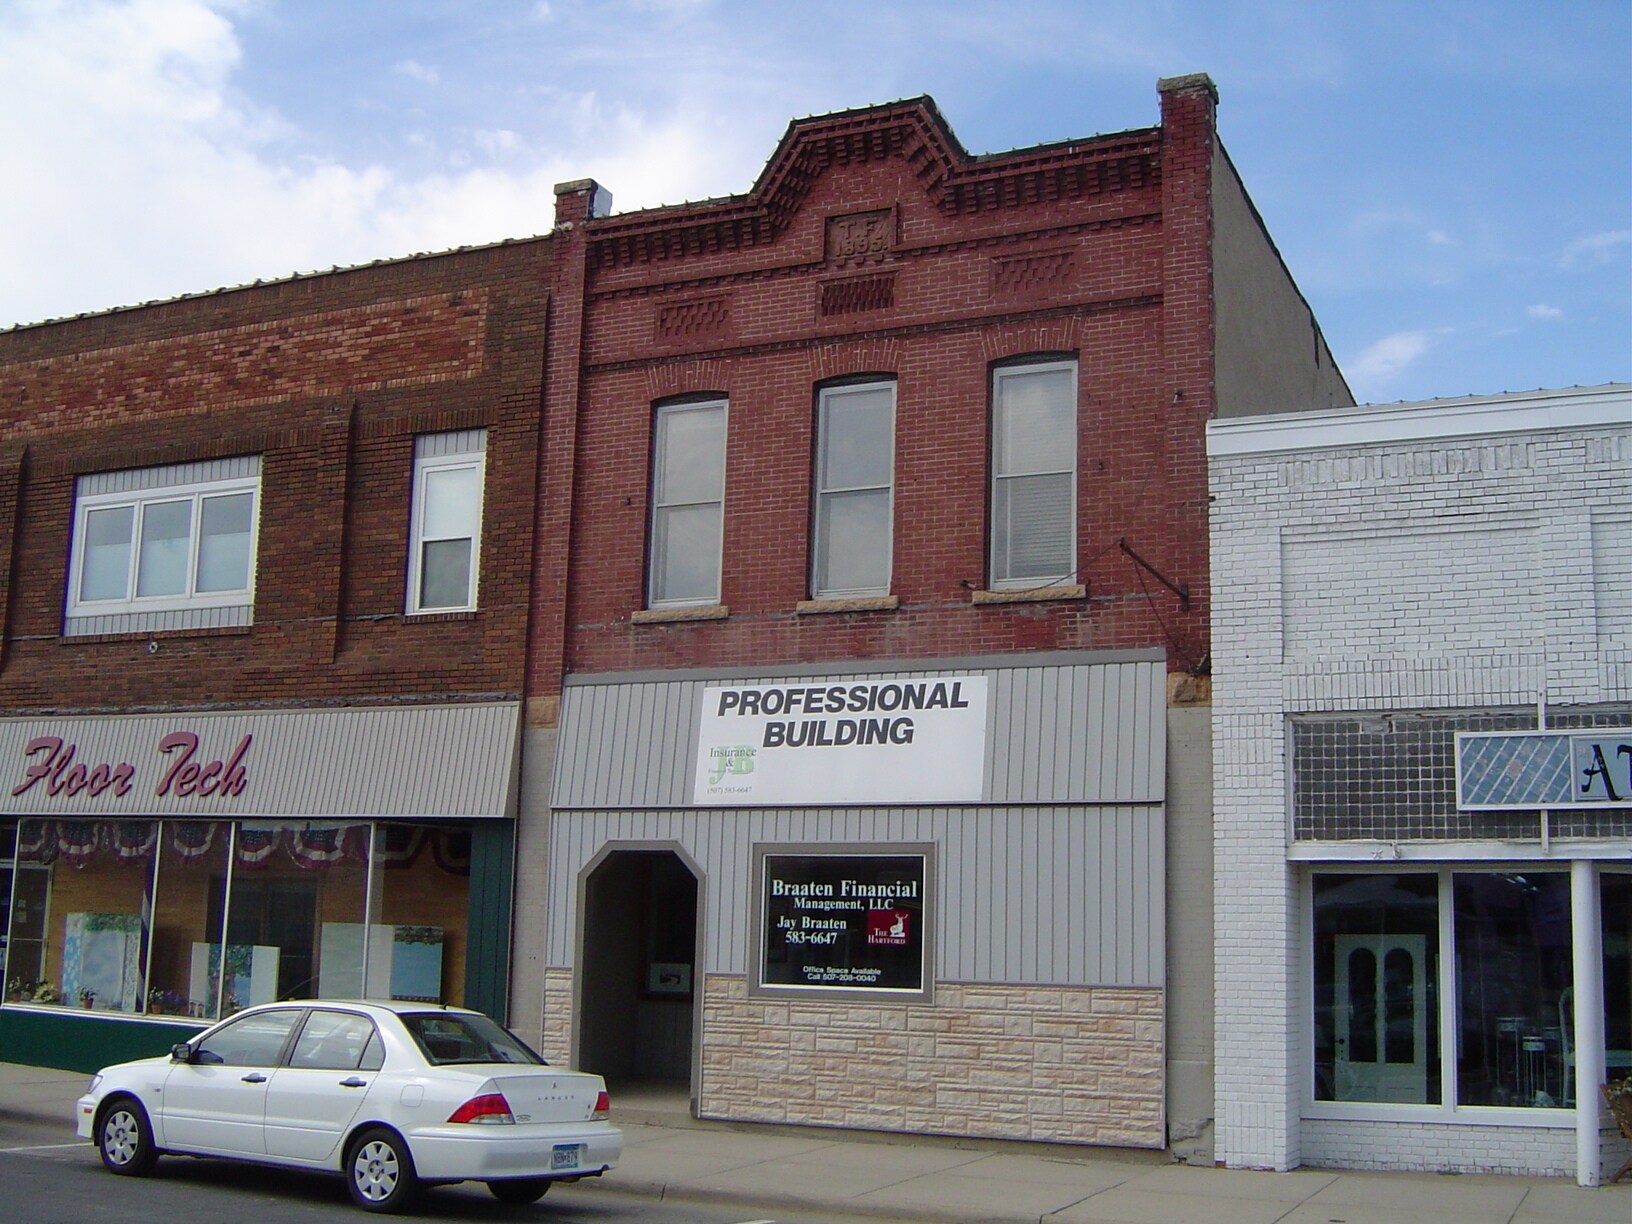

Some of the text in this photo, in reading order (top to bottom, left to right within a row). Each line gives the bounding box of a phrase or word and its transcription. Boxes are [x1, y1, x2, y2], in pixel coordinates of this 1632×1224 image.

[717, 681, 969, 717] PROFESSIONAL
[762, 717, 914, 748] BUILDING
[710, 747, 757, 758] Insurance
[12, 731, 252, 797] Floor Tech
[772, 879, 918, 898] Braaten Financial
[794, 897, 894, 912] Management, LLC
[777, 915, 847, 930] Jay Braaten
[785, 931, 838, 945] 583-6647
[803, 965, 882, 976] Office Space Available
